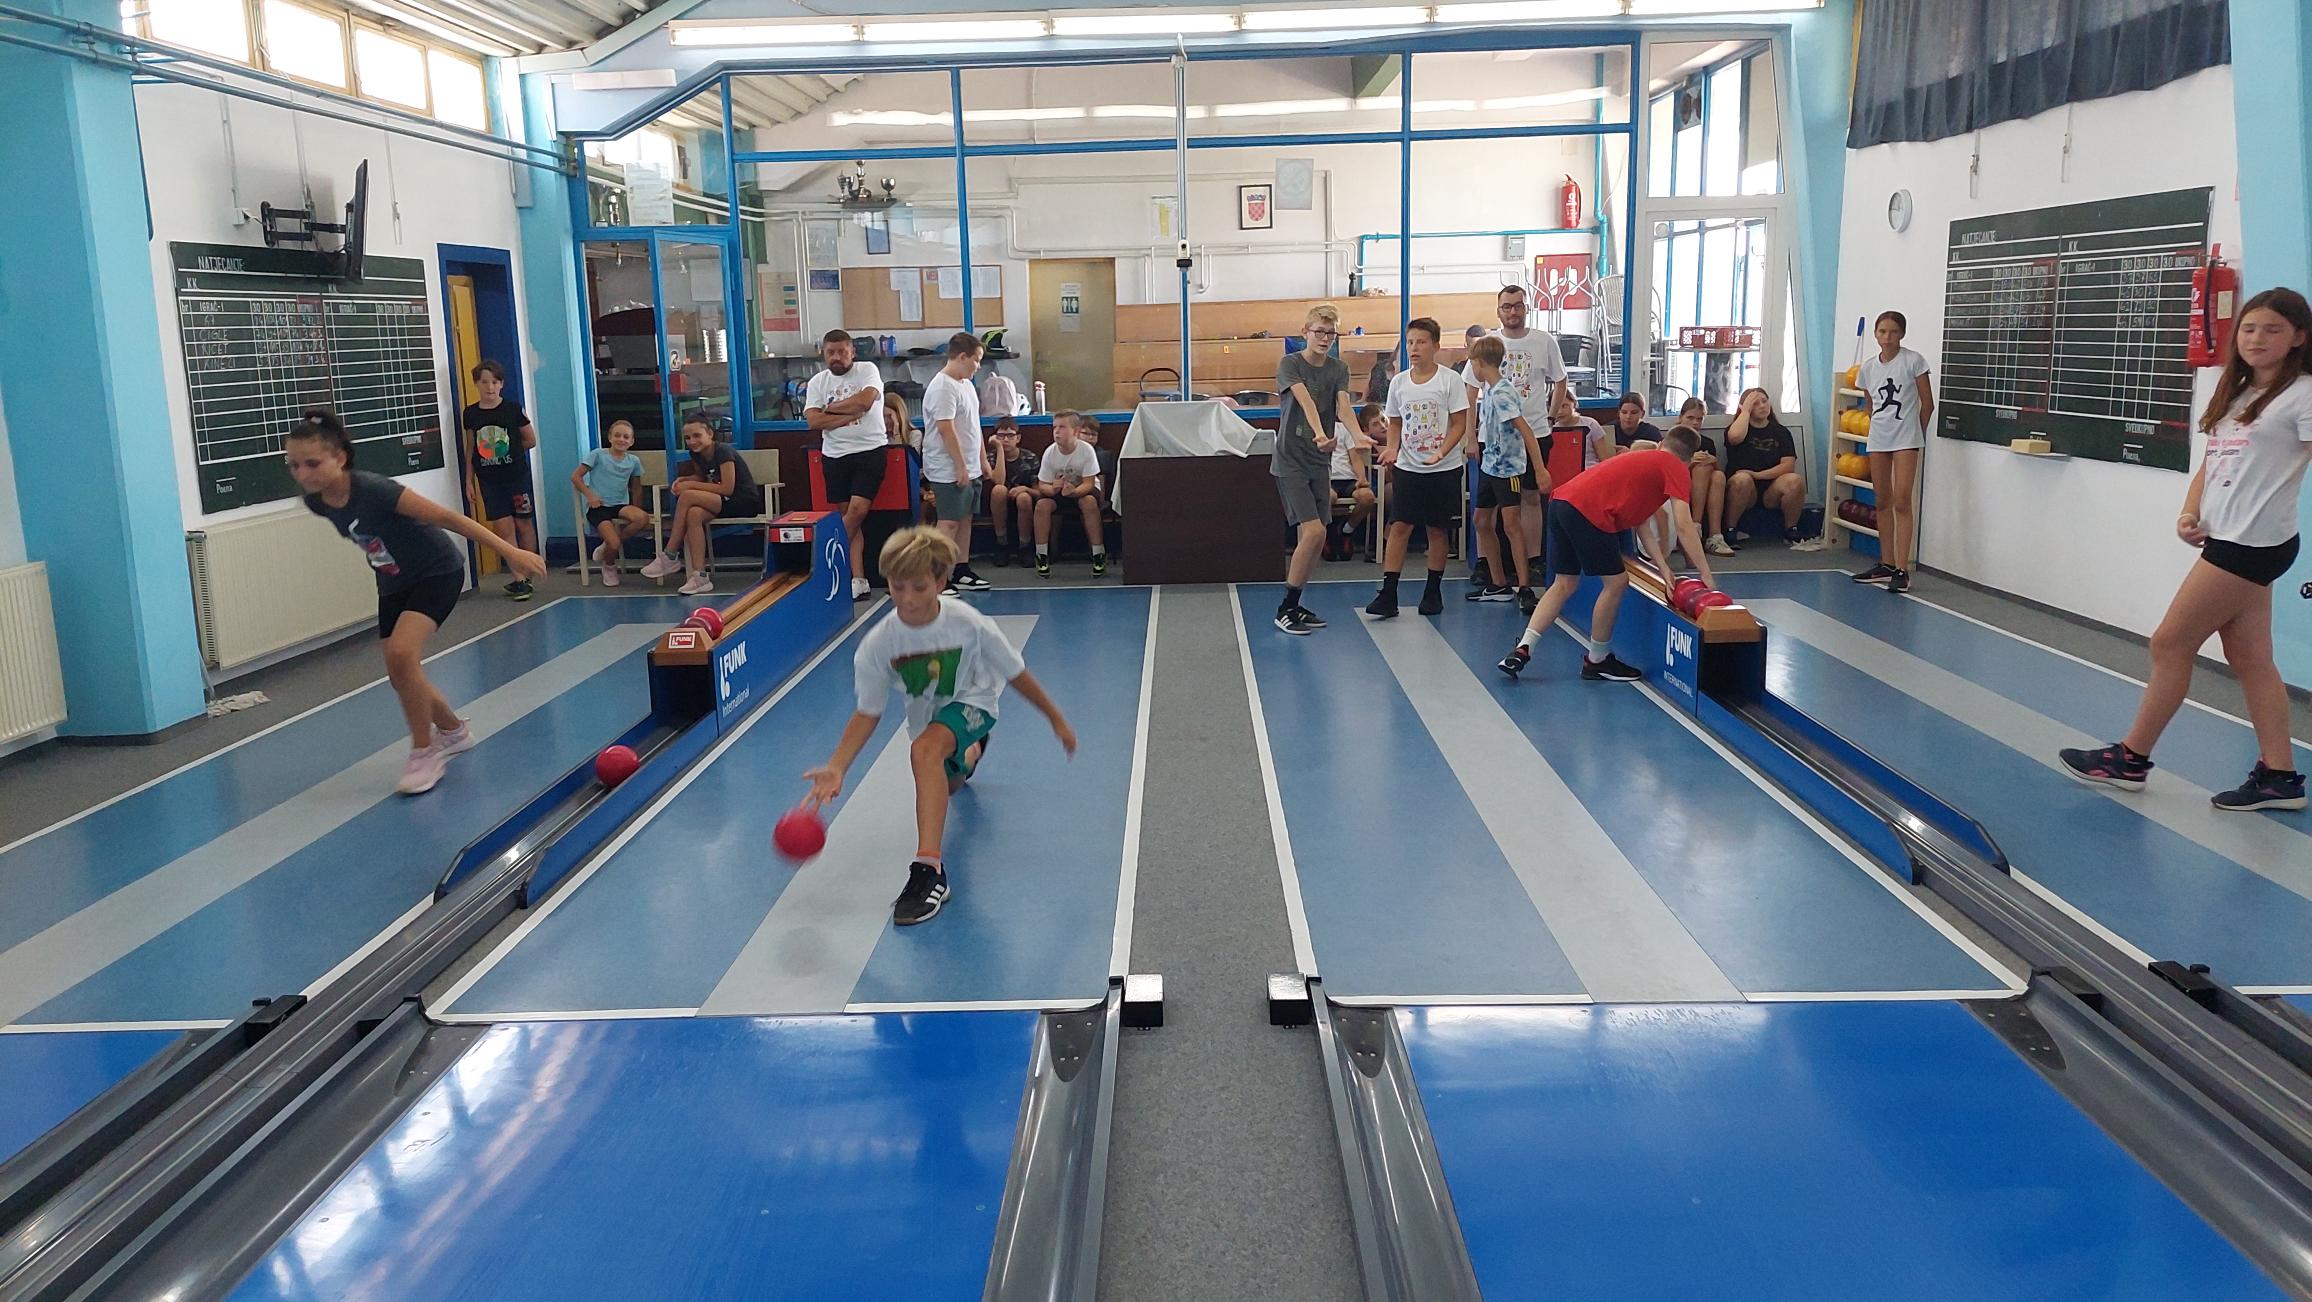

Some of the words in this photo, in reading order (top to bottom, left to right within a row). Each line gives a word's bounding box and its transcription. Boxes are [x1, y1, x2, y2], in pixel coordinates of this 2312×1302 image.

[2123, 260, 2133, 270] 30
[2136, 259, 2146, 269] 30
[2149, 258, 2159, 268] 30
[2163, 258, 2173, 268] 30
[252, 302, 261, 312] 30
[263, 303, 273, 312] 30
[275, 303, 285, 312] 30
[723, 640, 747, 678] FUNK
[1670, 625, 1693, 660] FUNK
[722, 682, 750, 718] International
